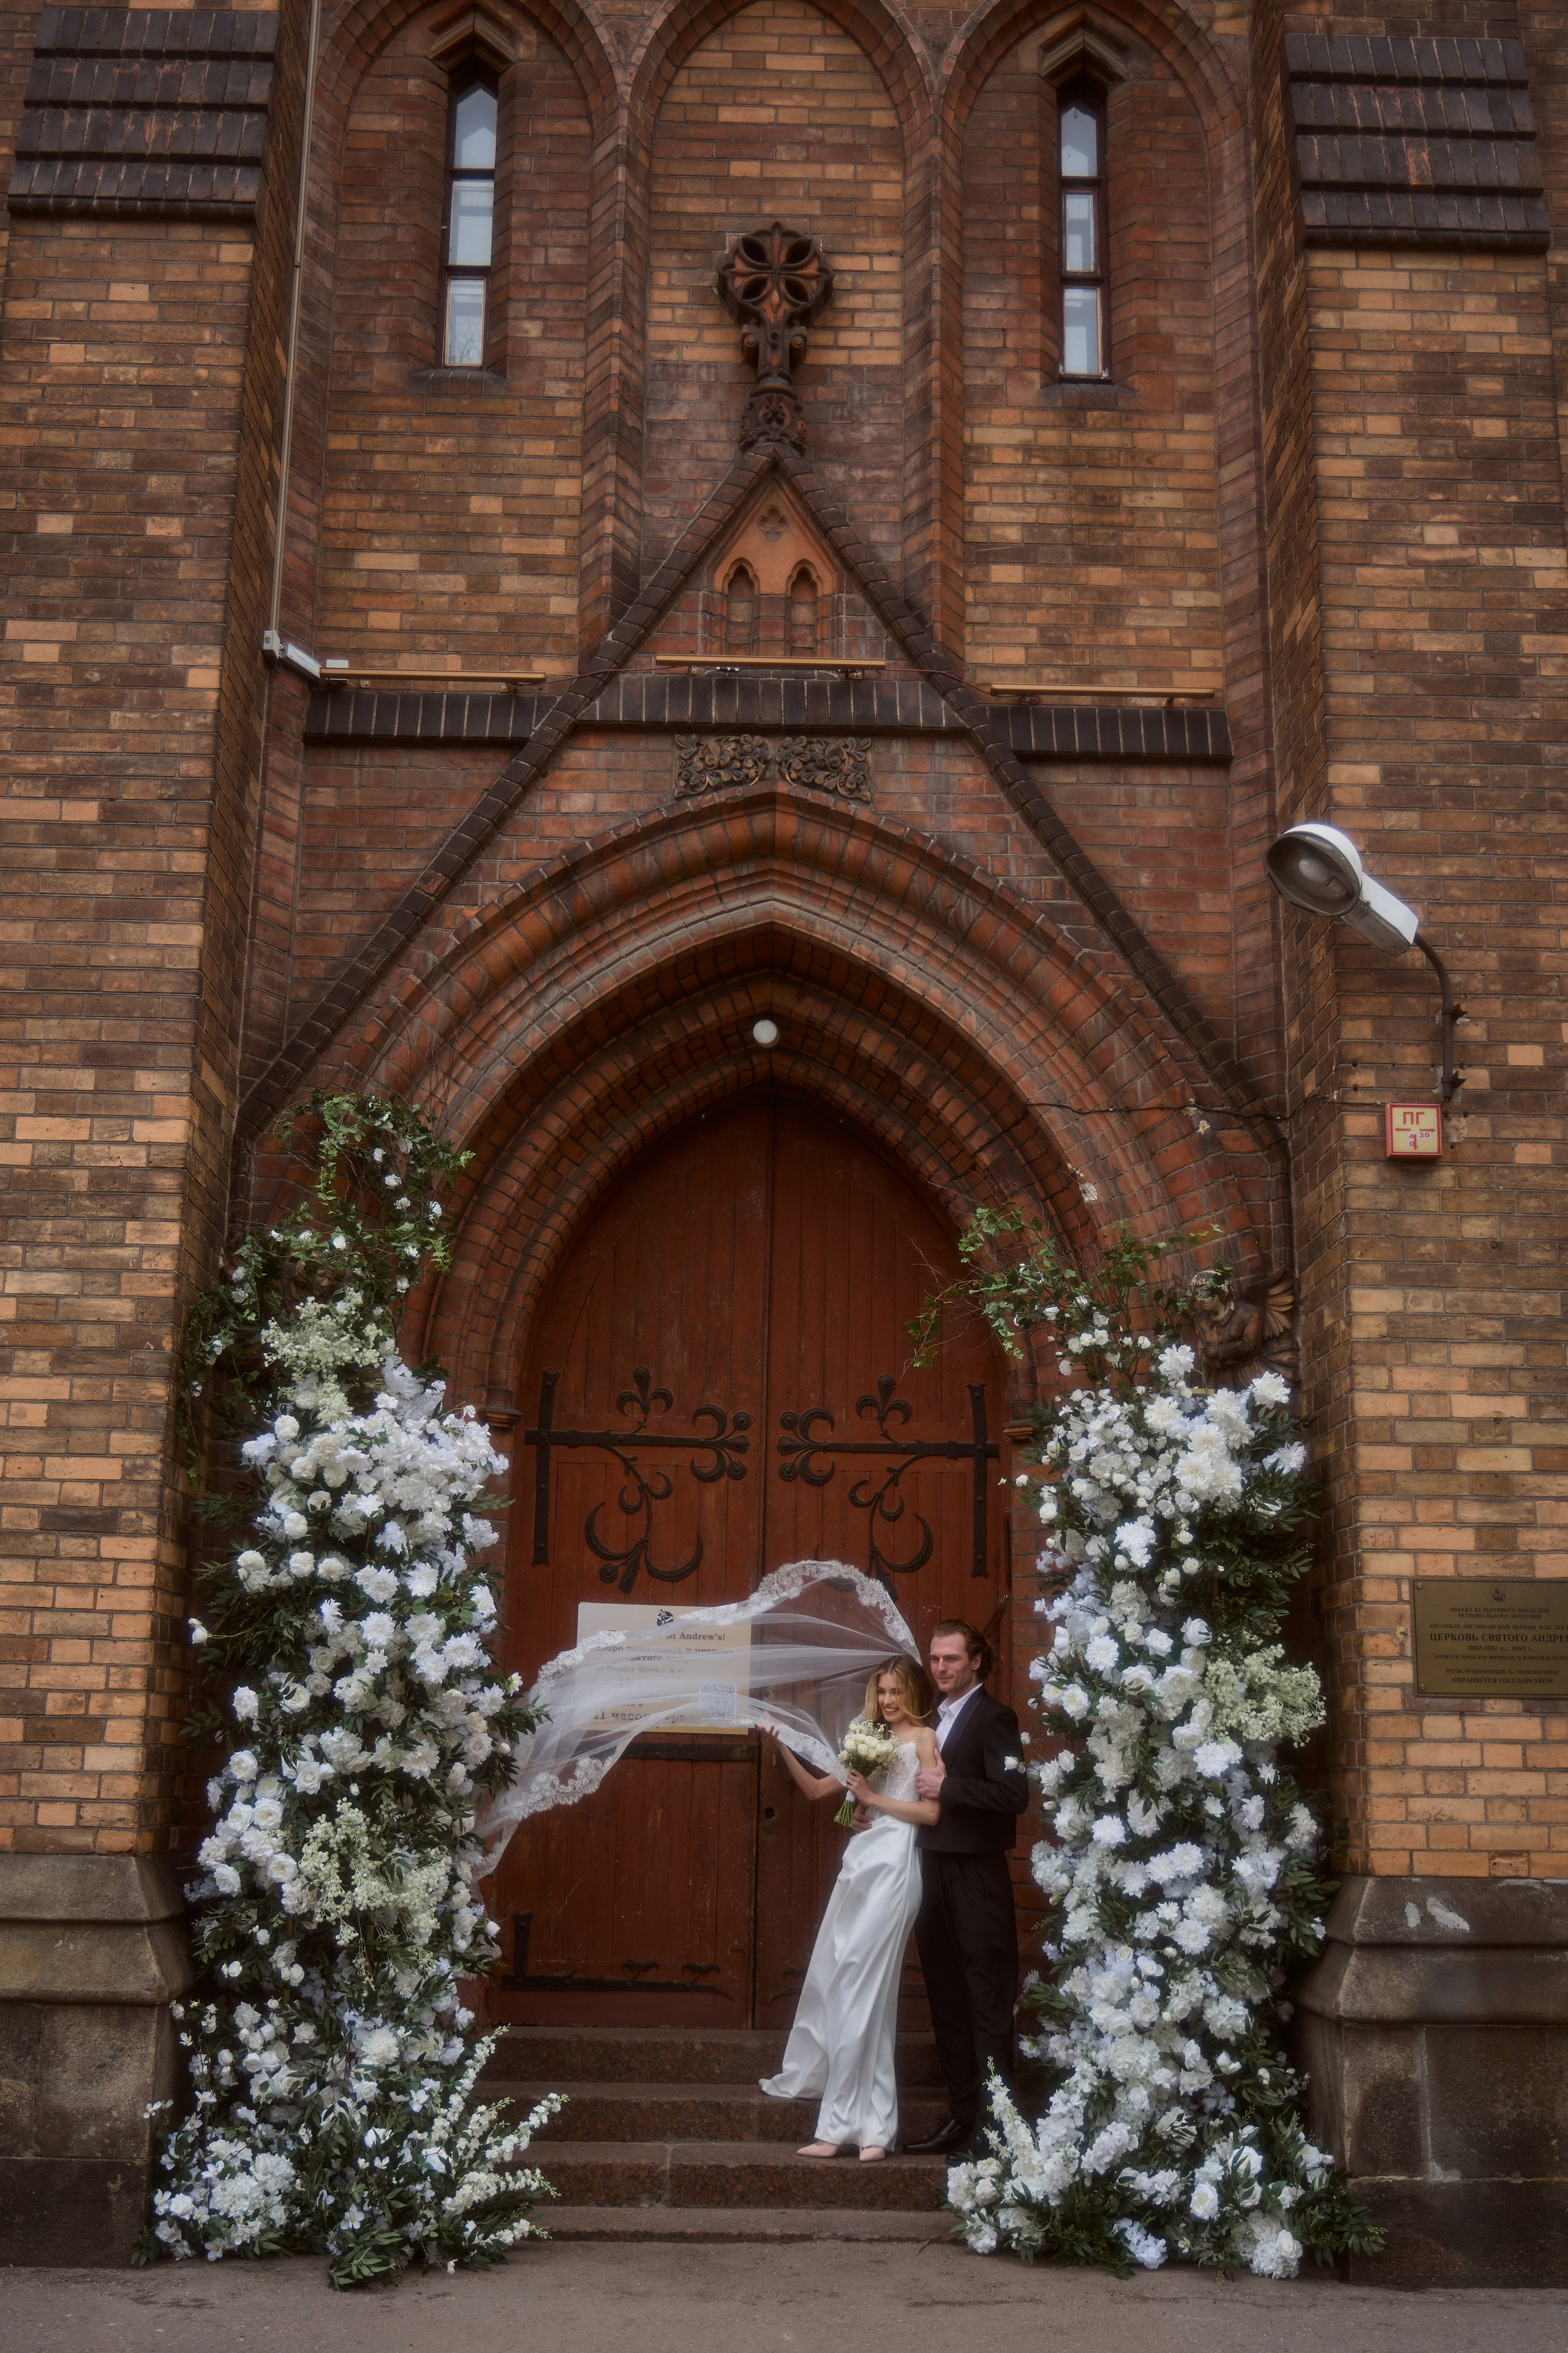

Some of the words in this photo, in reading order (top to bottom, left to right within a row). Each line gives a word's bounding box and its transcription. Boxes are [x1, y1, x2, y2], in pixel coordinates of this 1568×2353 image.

[1403, 1112, 1425, 1125] ПГ
[1430, 1633, 1479, 1642] ЦЕРКОВЬ
[607, 1665, 635, 1674] Sunday
